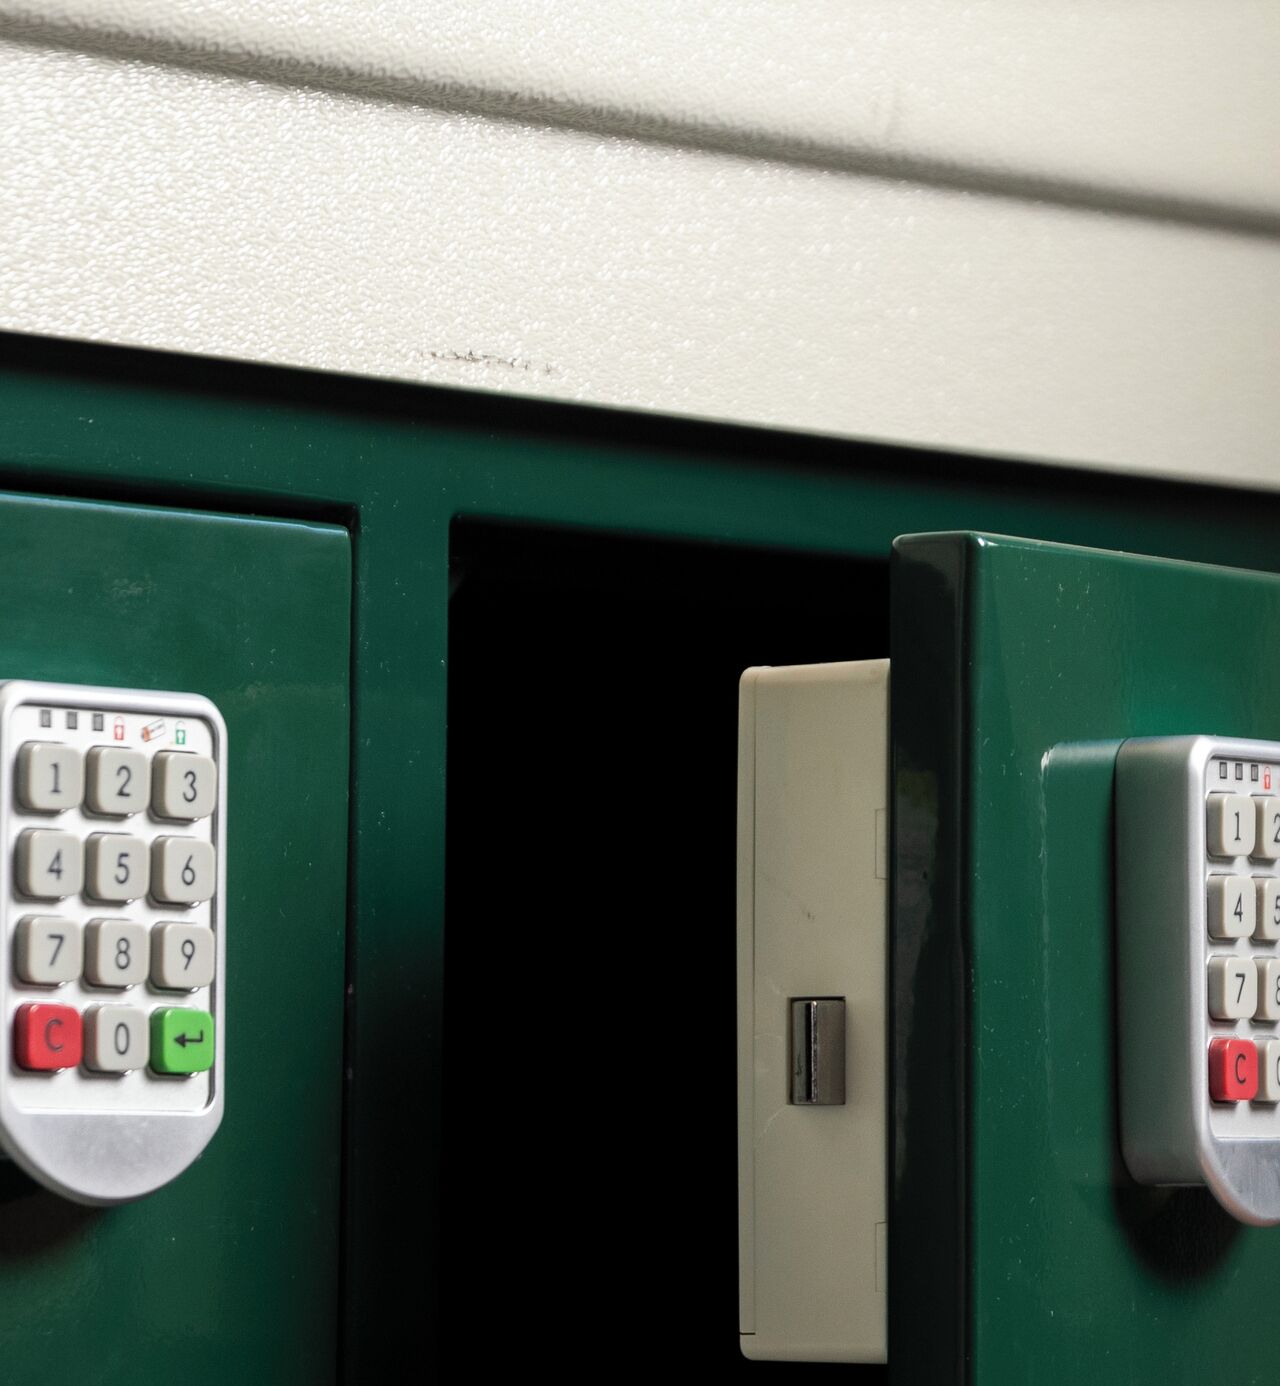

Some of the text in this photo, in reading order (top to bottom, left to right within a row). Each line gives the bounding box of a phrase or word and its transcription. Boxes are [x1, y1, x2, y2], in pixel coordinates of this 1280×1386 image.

[51, 763, 197, 803] 1 2 3
[1234, 811, 1242, 841] 1
[47, 849, 196, 886] 4 5 6
[1233, 892, 1243, 922] 4
[48, 934, 195, 970] 7 8 9
[1235, 973, 1246, 1004] 7
[44, 1018, 130, 1056] C 0
[1235, 1053, 1247, 1085] C
